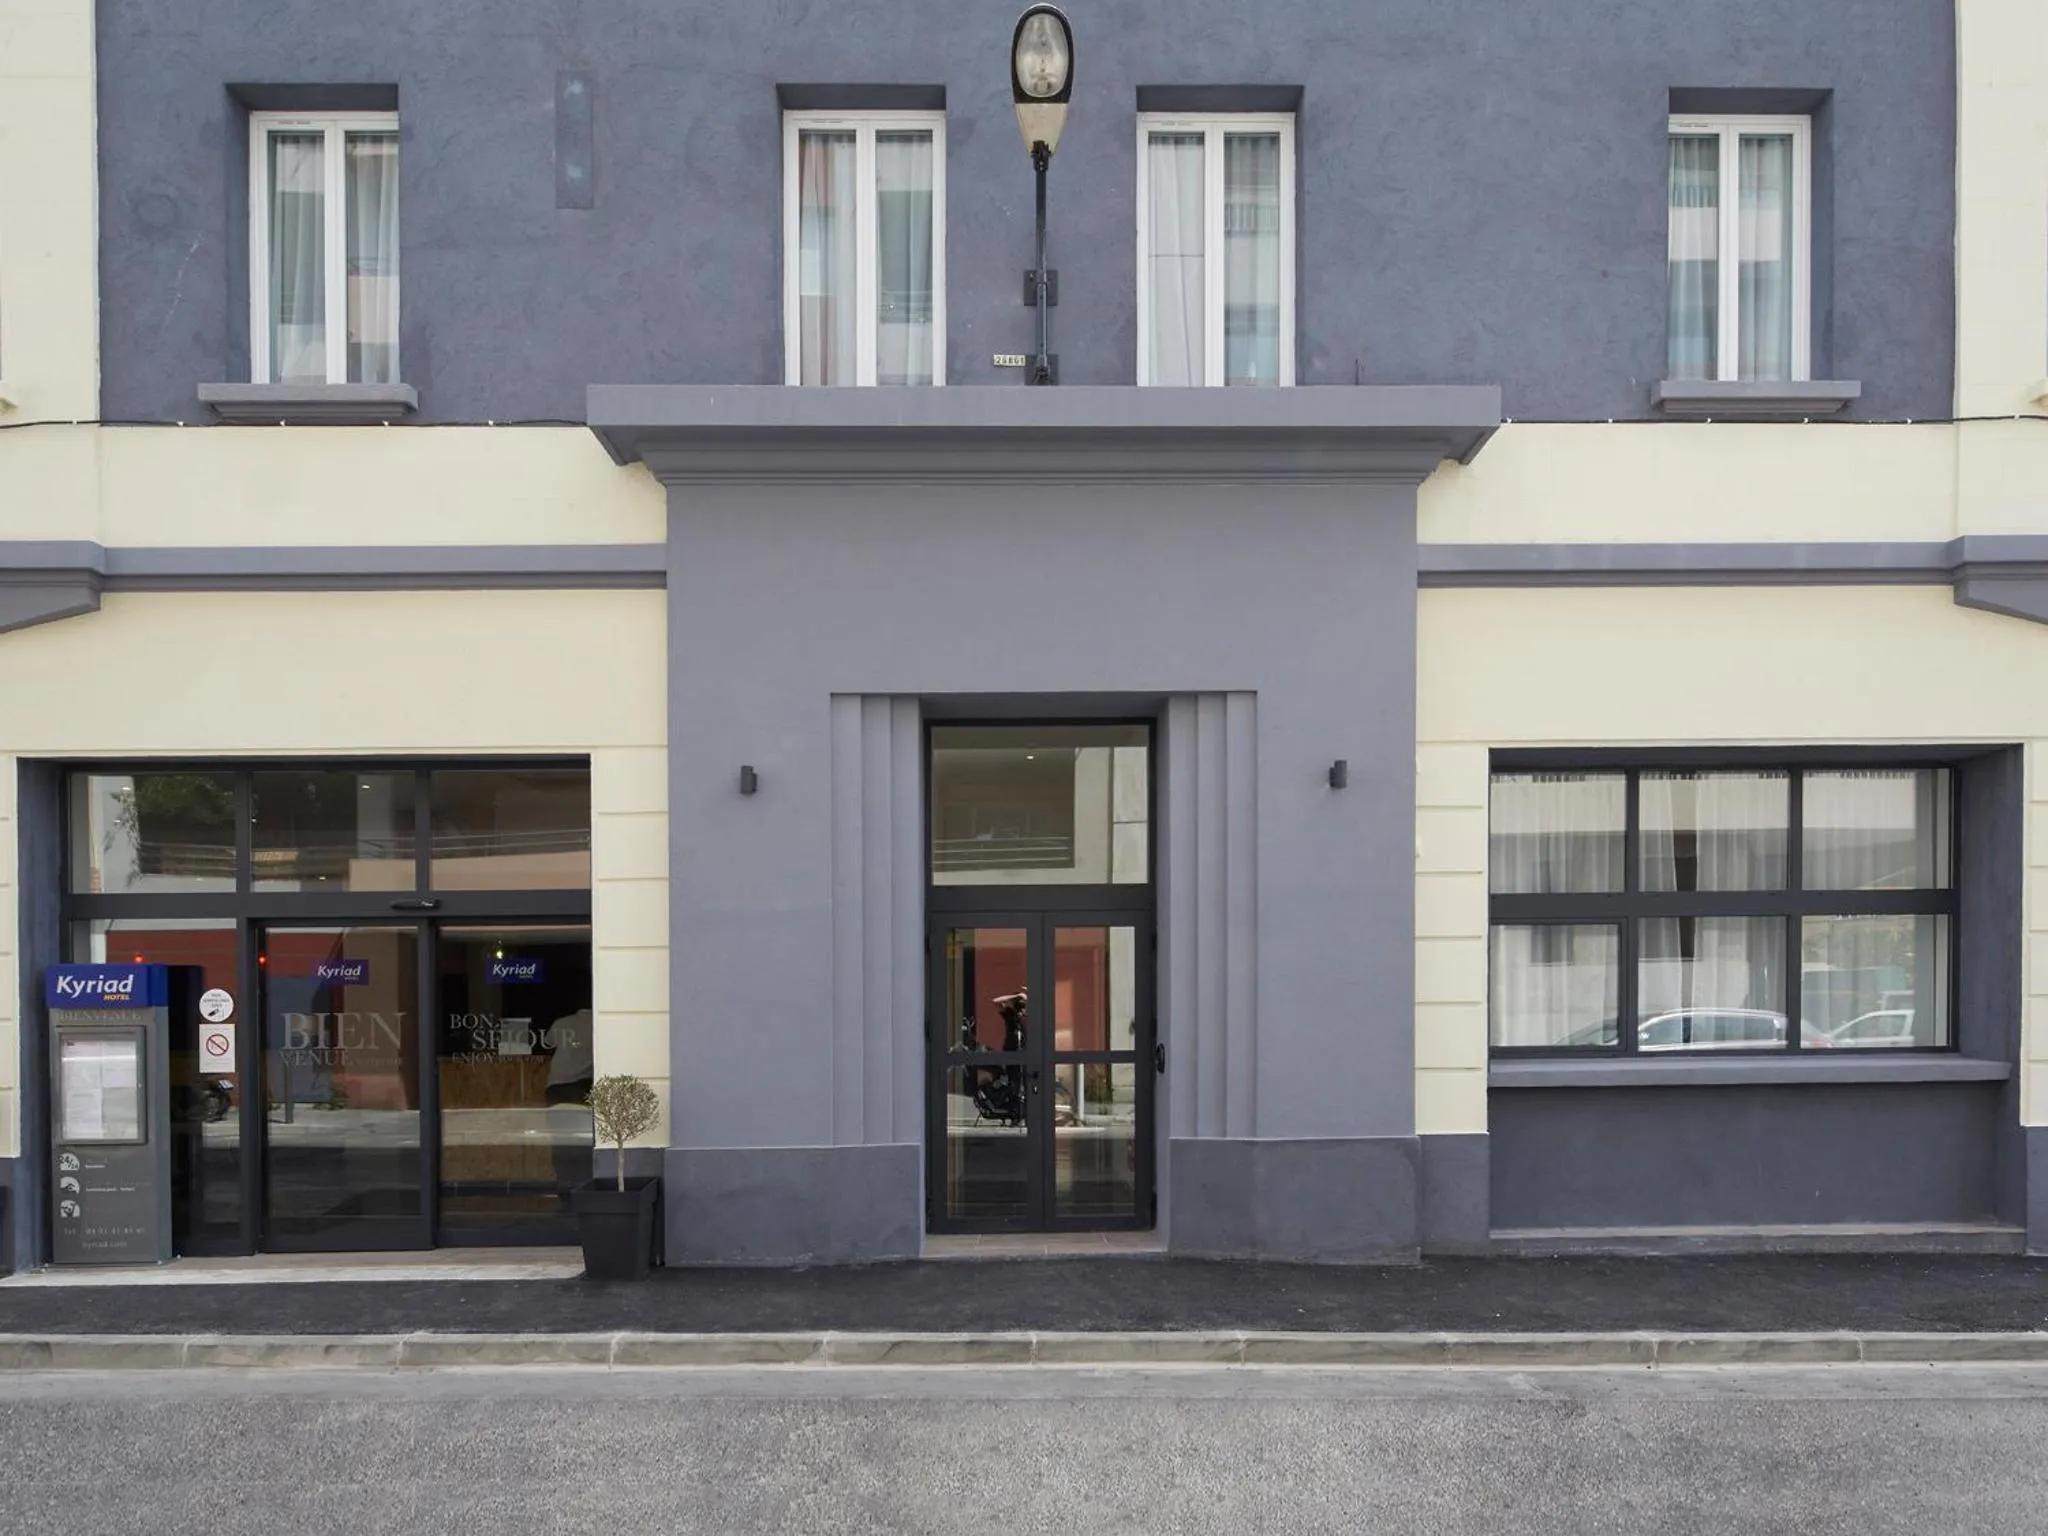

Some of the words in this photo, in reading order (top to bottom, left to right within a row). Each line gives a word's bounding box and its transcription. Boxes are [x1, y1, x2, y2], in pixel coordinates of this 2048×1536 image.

[317, 965, 362, 979] Kyriad
[492, 963, 536, 977] Kyriad
[56, 974, 134, 998] Kyriad
[281, 1012, 407, 1050] BIEN
[280, 1050, 354, 1067] VENUE
